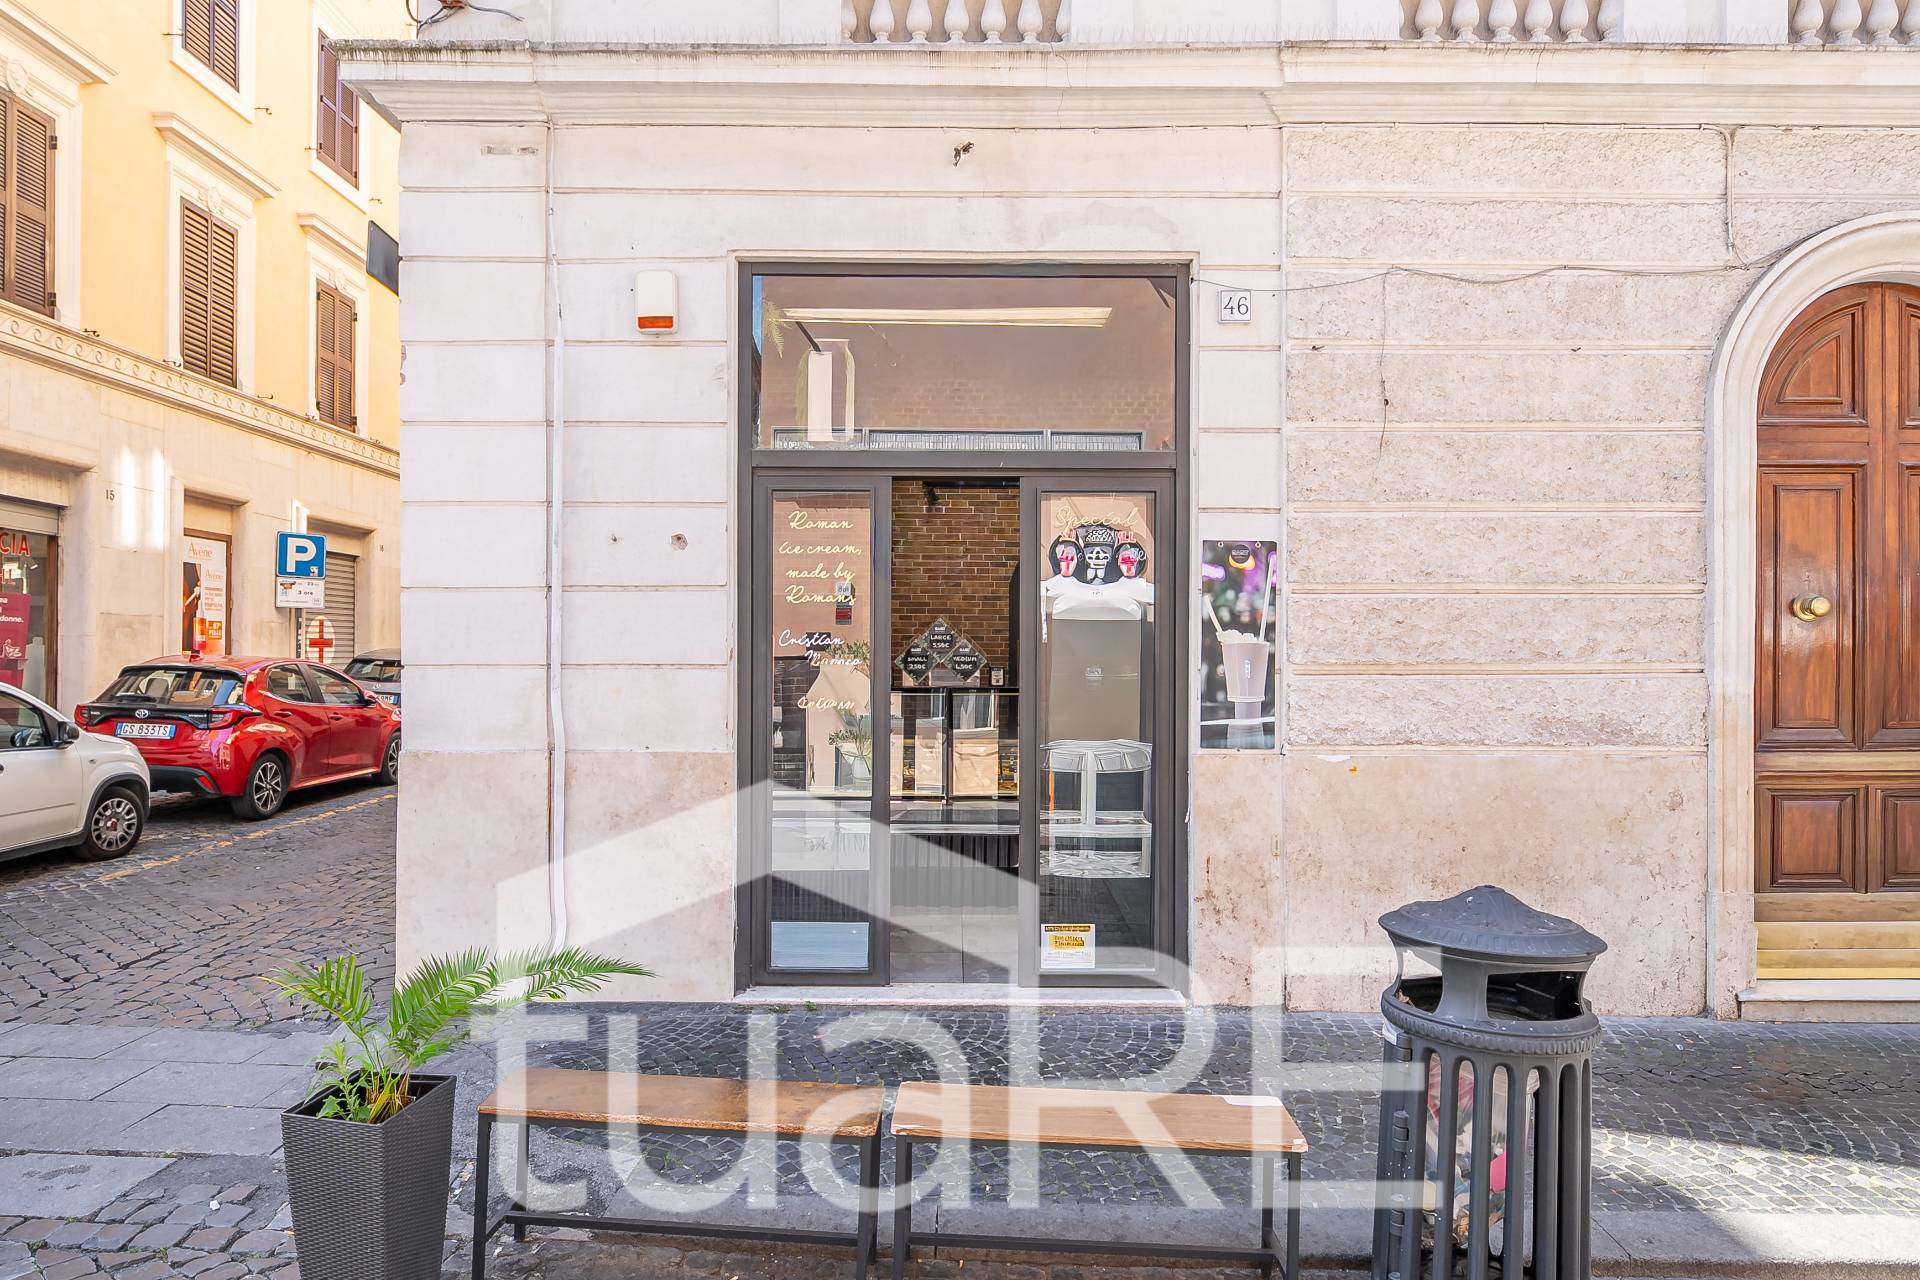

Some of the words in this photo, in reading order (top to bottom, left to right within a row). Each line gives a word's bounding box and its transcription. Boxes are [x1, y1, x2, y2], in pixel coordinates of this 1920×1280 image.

[1223, 296, 1249, 315] 46
[105, 489, 115, 501] 15
[788, 510, 854, 530] Roman
[286, 537, 317, 573] P
[807, 545, 862, 555] cream,
[786, 562, 830, 579] made
[833, 562, 855, 588] by
[785, 584, 856, 606] Romans
[779, 629, 844, 648] Cristian
[122, 723, 136, 734] GS
[138, 724, 169, 736] 833TS
